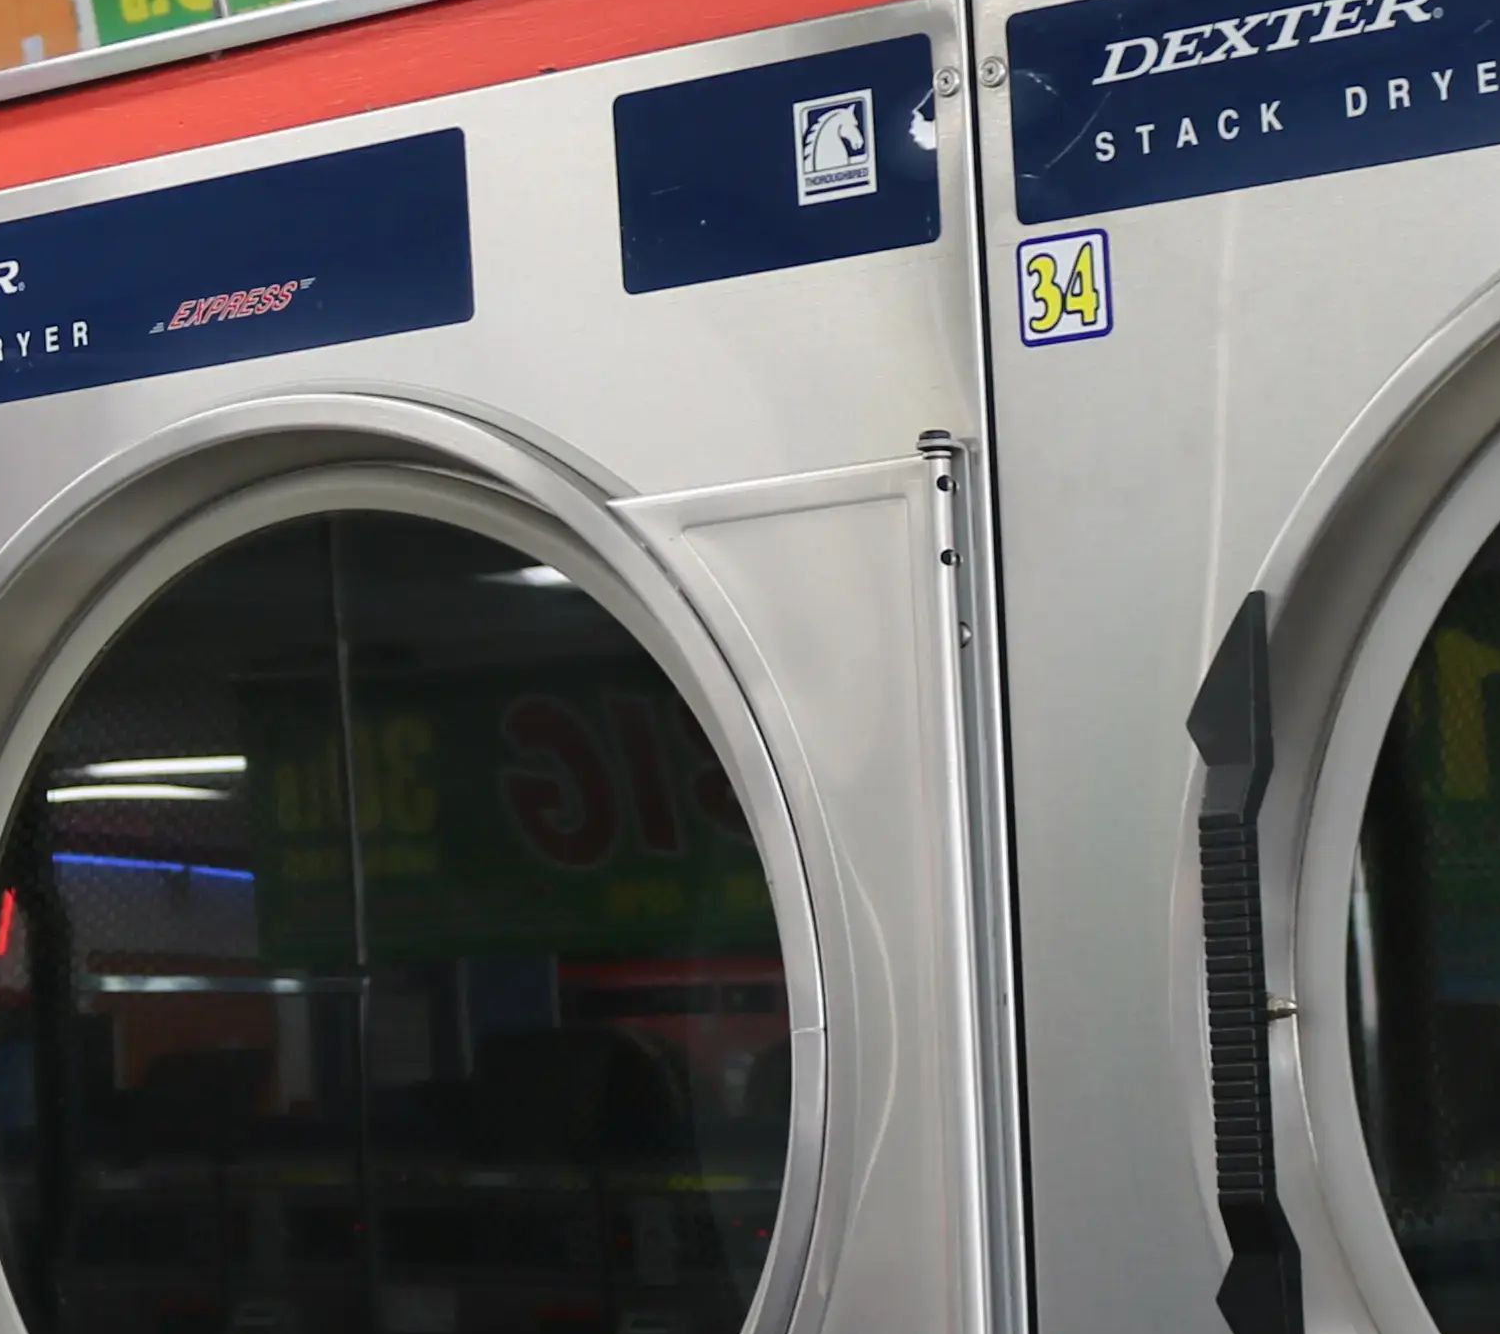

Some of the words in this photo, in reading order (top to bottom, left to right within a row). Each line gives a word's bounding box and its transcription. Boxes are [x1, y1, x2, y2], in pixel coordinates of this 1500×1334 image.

[1093, 99, 1285, 164] STACK
[803, 167, 870, 188] THOROUGHBRED
[166, 279, 299, 332] EXPRESS
[1025, 241, 1101, 336] 34
